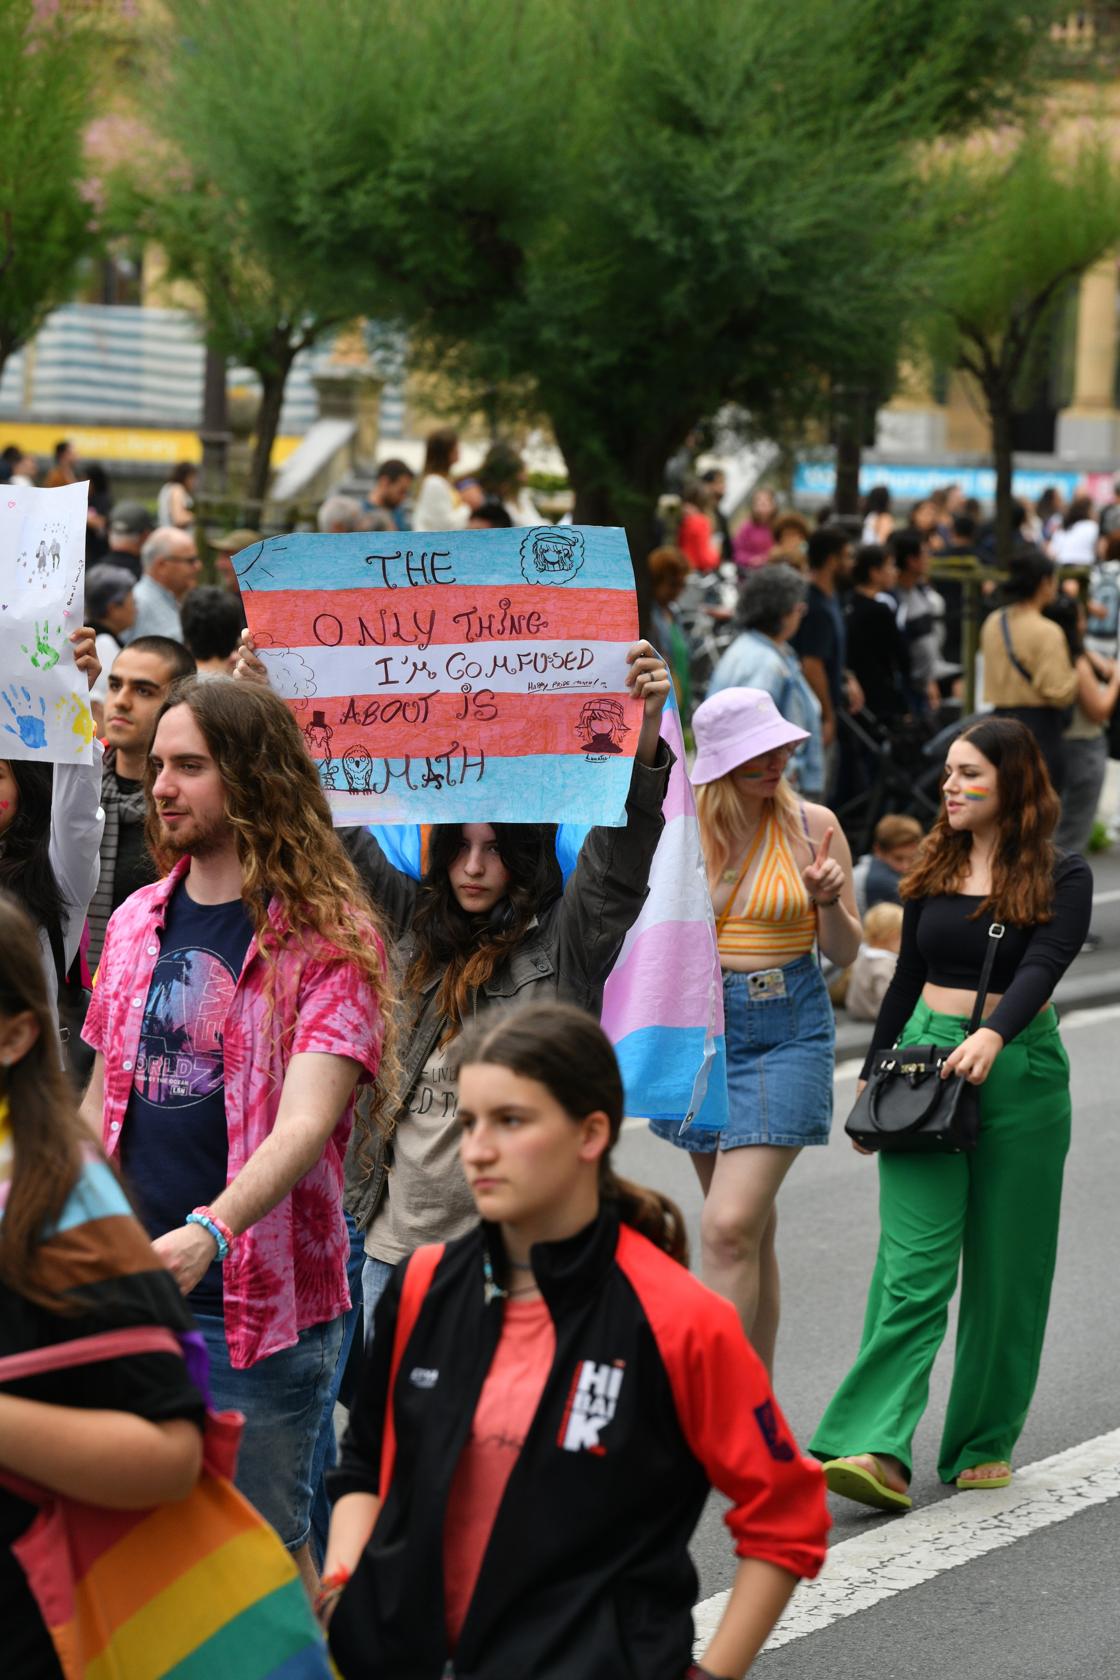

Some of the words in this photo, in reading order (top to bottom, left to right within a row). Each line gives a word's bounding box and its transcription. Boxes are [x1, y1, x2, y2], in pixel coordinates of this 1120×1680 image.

[365, 550, 456, 590] THE
[313, 608, 436, 651] ONLY
[339, 689, 441, 727] ABOUT
[373, 740, 485, 794] MATH
